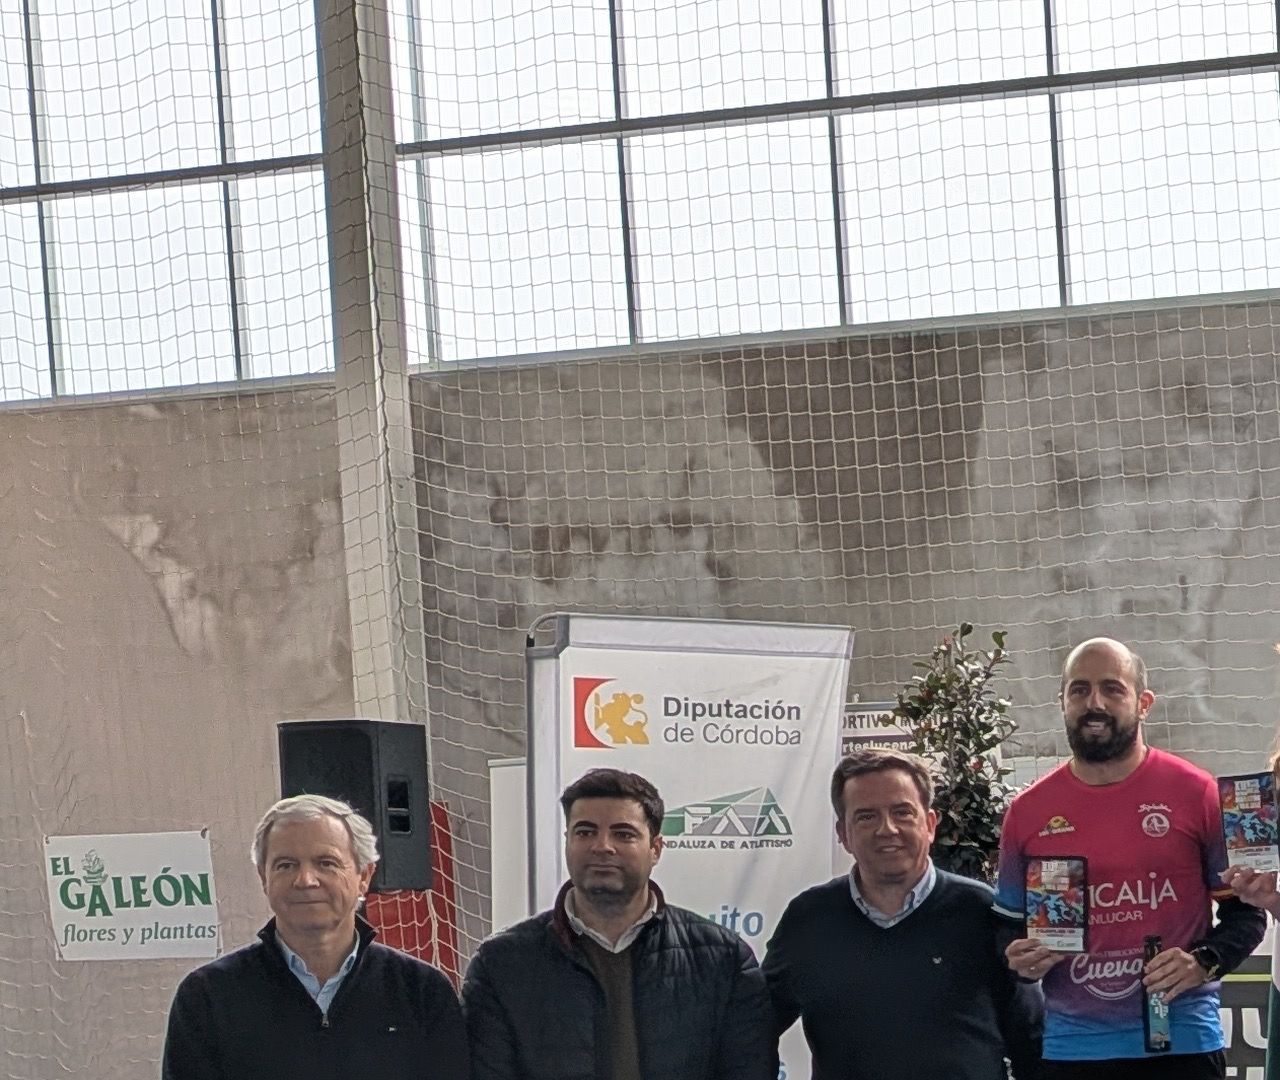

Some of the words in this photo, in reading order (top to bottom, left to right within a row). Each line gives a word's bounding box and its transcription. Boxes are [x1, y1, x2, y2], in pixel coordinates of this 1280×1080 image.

[663, 696, 801, 721] Diputación
[663, 723, 694, 743] de
[702, 723, 801, 746] Córdoba
[662, 838, 715, 849] NDALUZA
[720, 840, 735, 849] DE
[741, 838, 793, 849] ATLETISMO
[50, 857, 75, 876] EL
[59, 867, 212, 917] GALEÓN
[60, 923, 117, 947] flores
[121, 927, 134, 945] y
[140, 922, 217, 944] plantas
